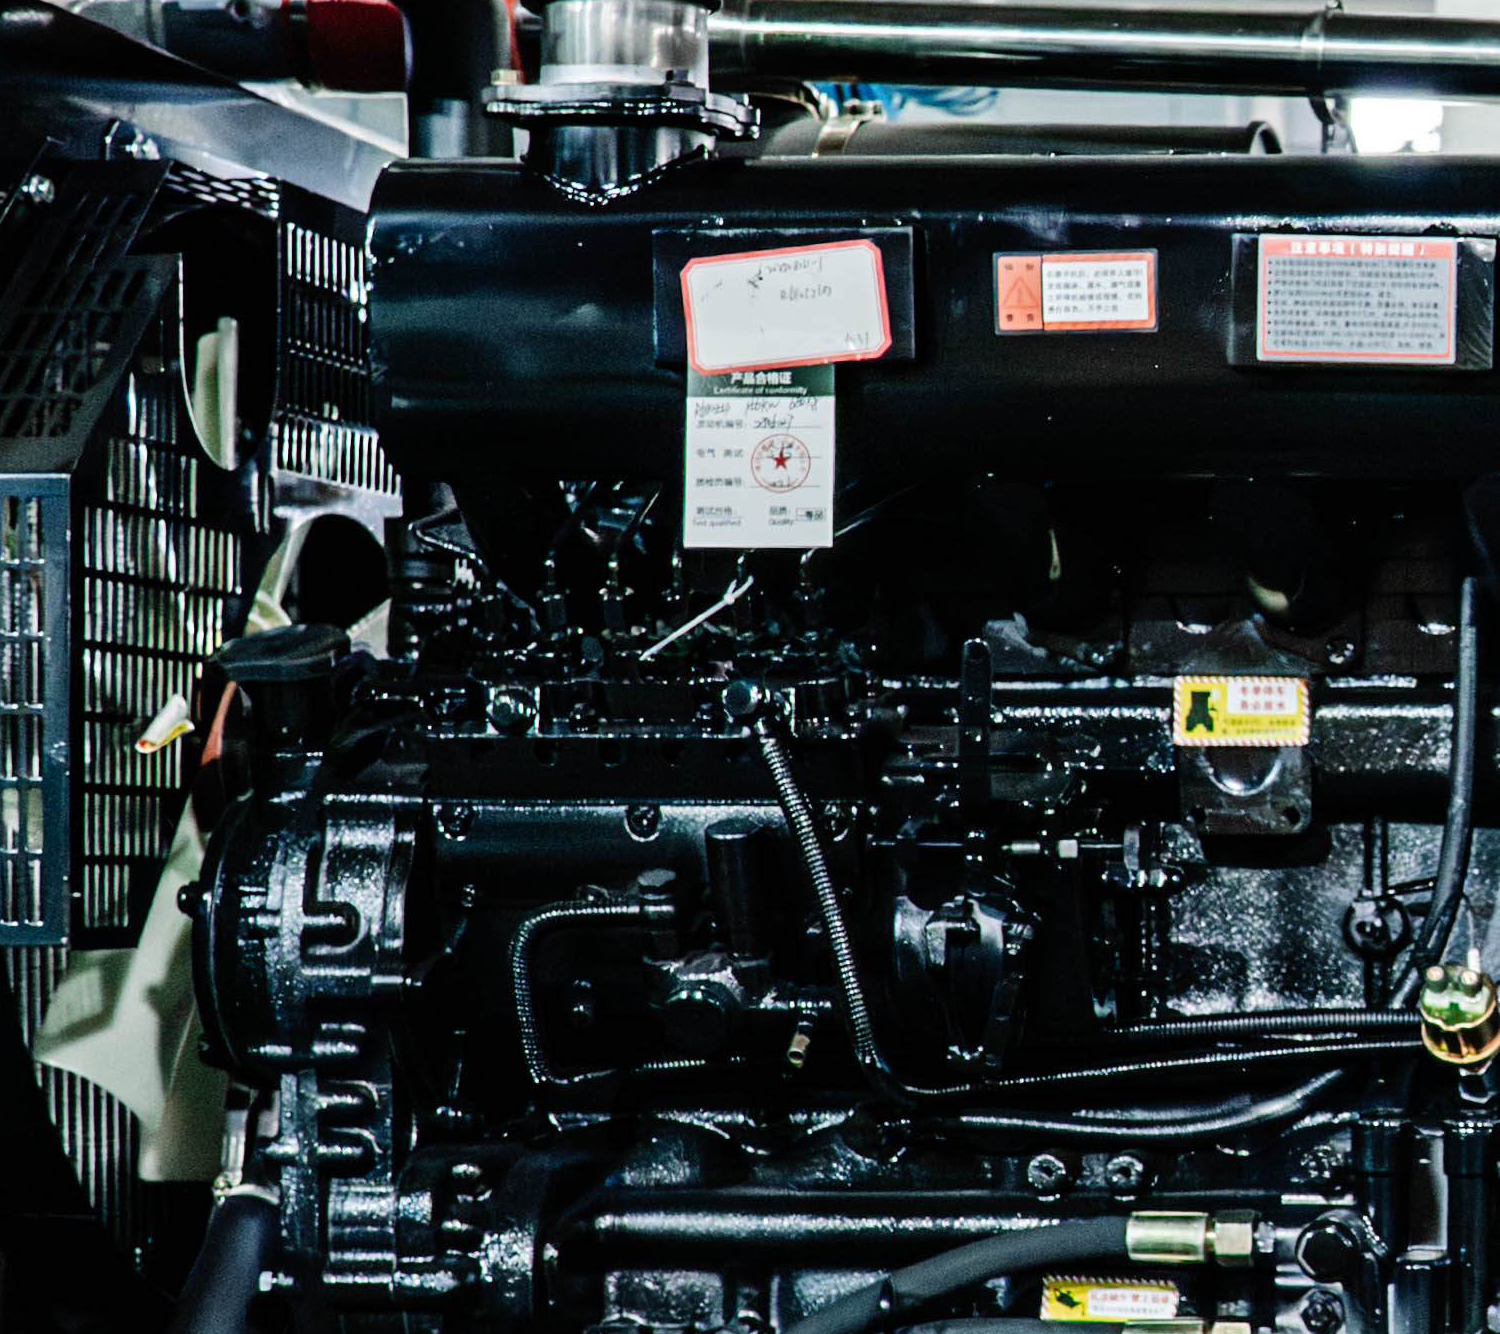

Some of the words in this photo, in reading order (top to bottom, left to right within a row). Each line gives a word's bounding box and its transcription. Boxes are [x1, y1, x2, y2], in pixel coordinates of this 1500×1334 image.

[731, 371, 792, 385] 产品合格证
